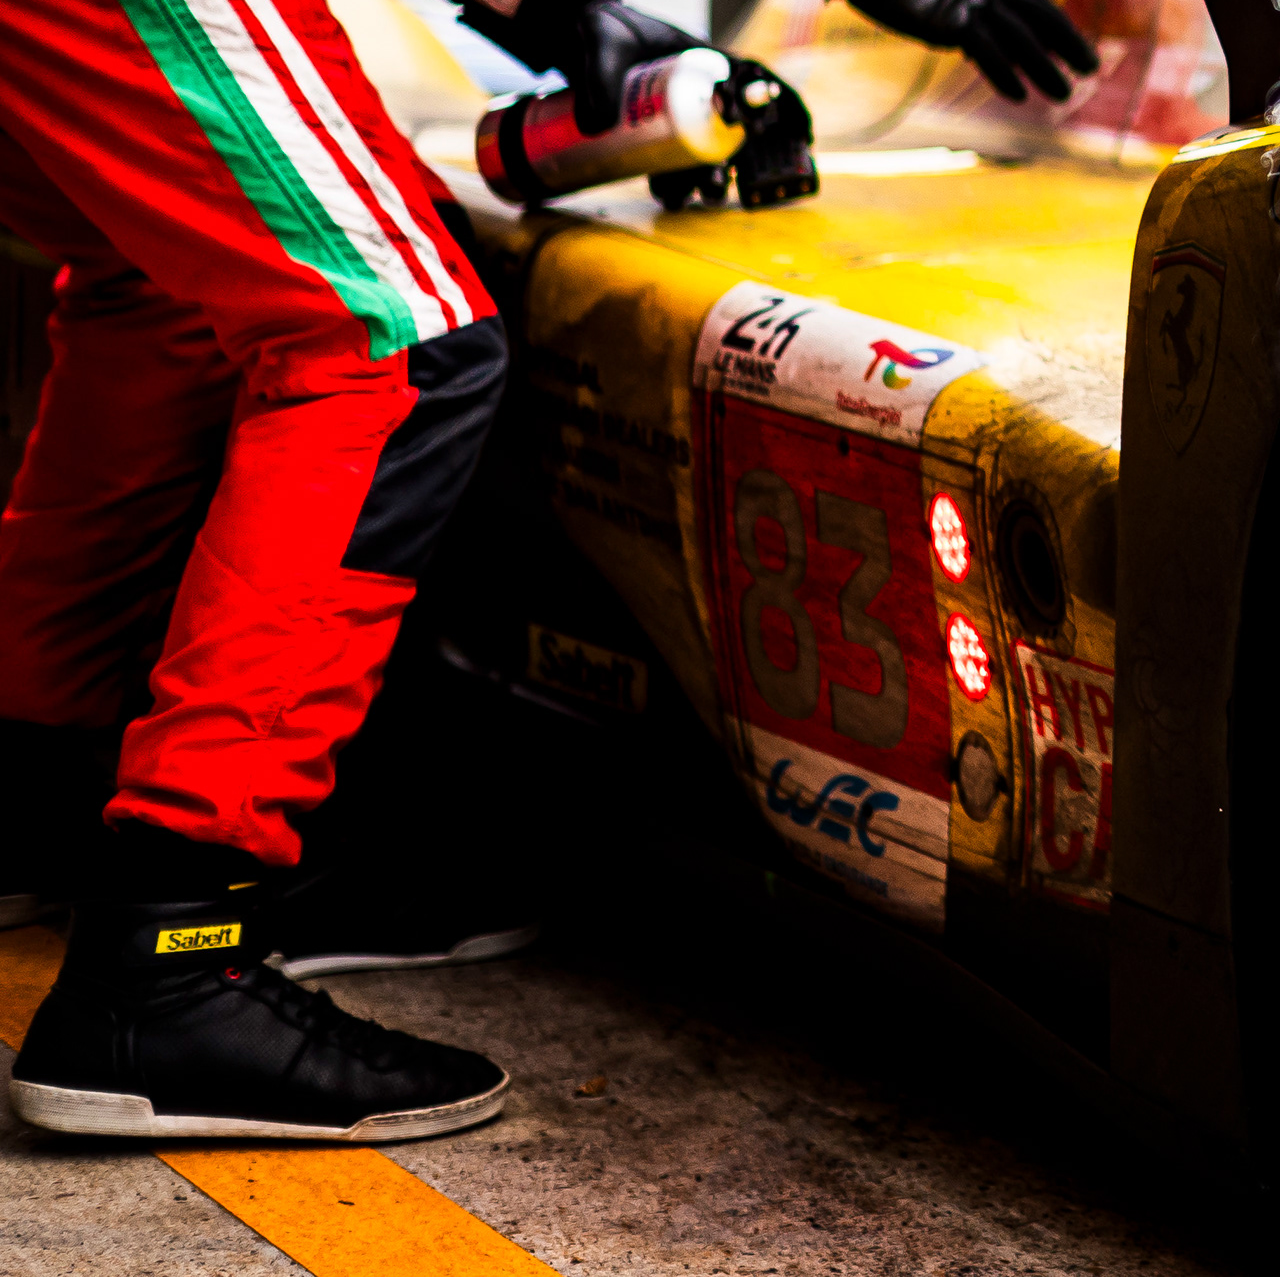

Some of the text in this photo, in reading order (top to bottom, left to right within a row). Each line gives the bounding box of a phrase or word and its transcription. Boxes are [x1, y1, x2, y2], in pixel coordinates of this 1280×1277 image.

[734, 469, 911, 750] 83
[1025, 662, 1115, 756] HYP
[167, 927, 232, 951] Sabelt
